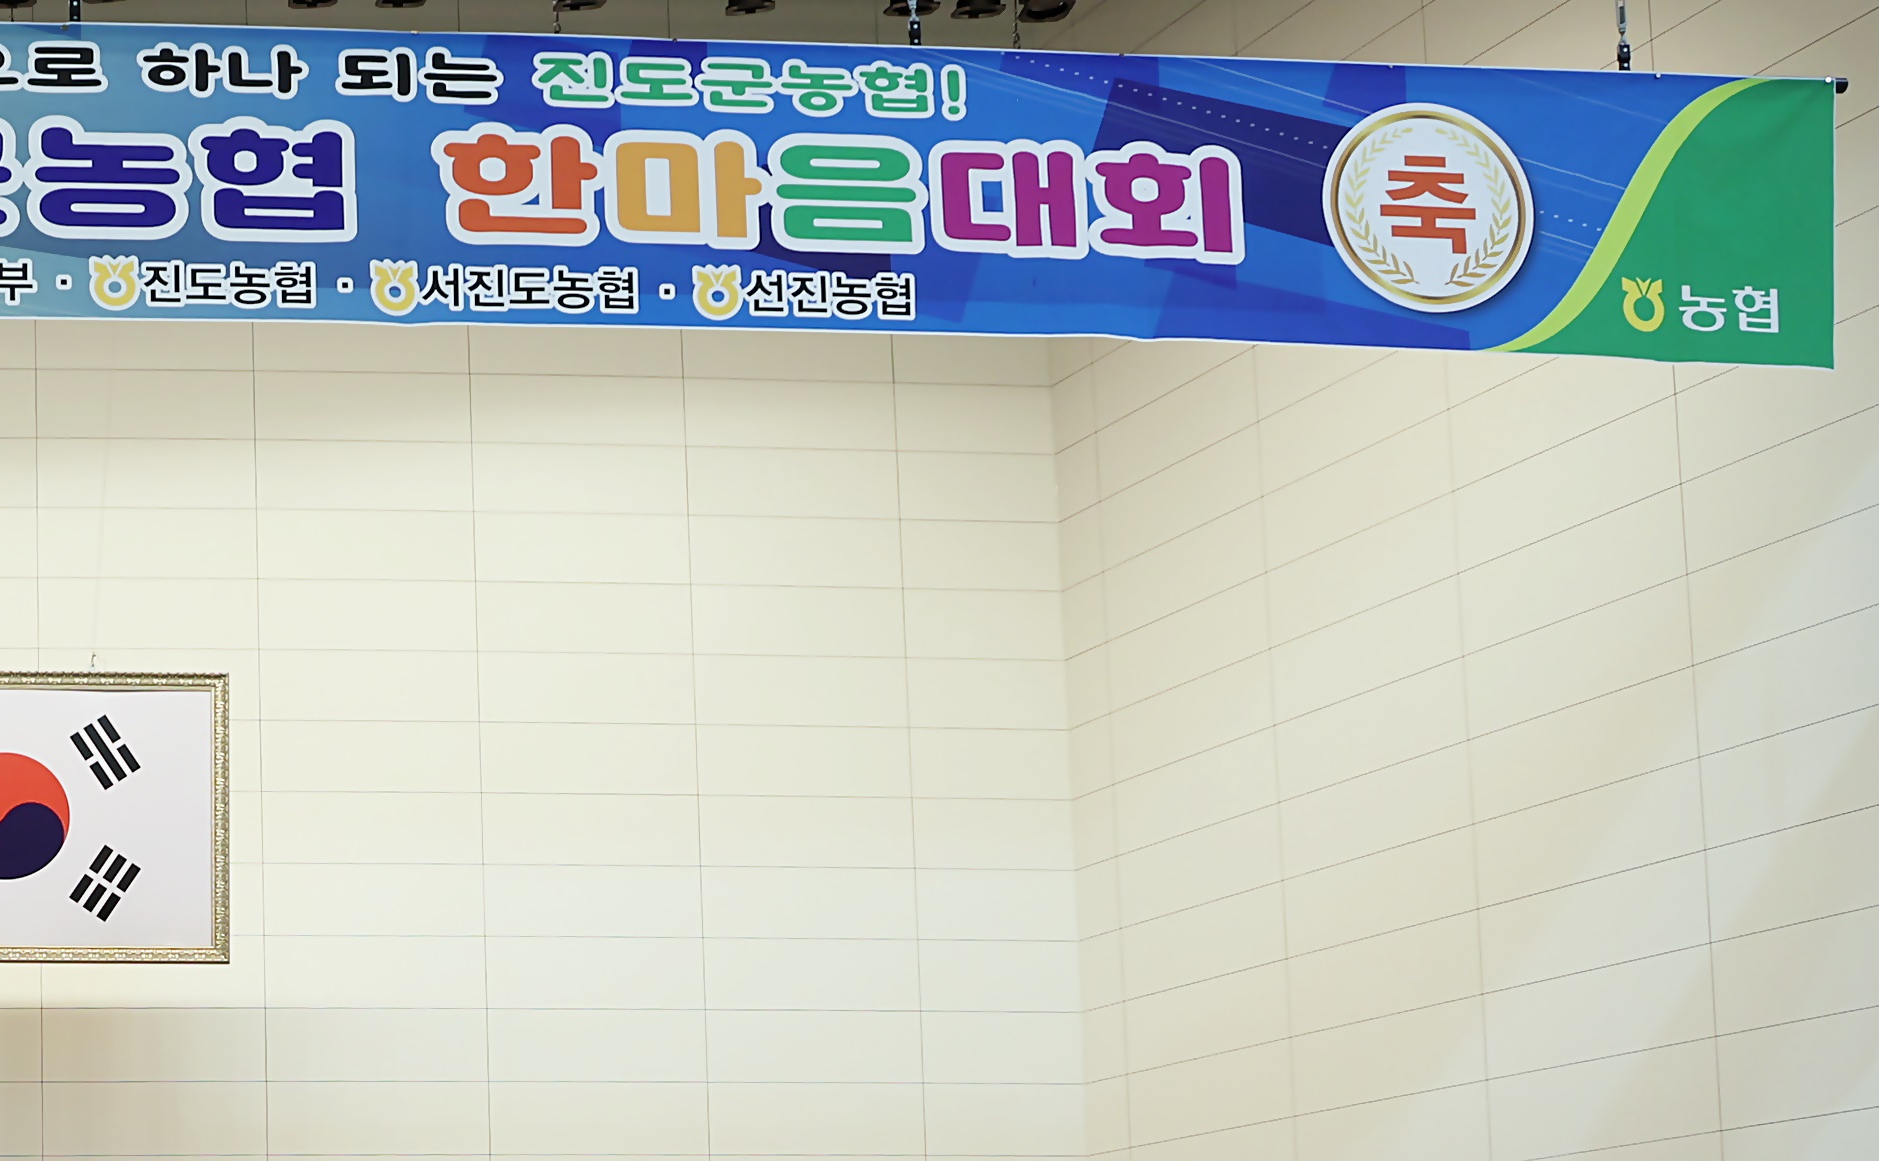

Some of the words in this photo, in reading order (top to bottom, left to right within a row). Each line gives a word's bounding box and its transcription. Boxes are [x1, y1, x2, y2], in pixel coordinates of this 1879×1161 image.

[144, 48, 301, 95] 하나
[341, 51, 498, 100] 되는
[538, 57, 962, 115] 진도군농협!
[443, 133, 1238, 254] 한마음대회
[1380, 155, 1476, 254] 축
[144, 264, 315, 305] 진도농협
[423, 268, 637, 311] 서진도농협
[748, 276, 914, 318] 선진농협
[1680, 285, 1780, 334] 농협
